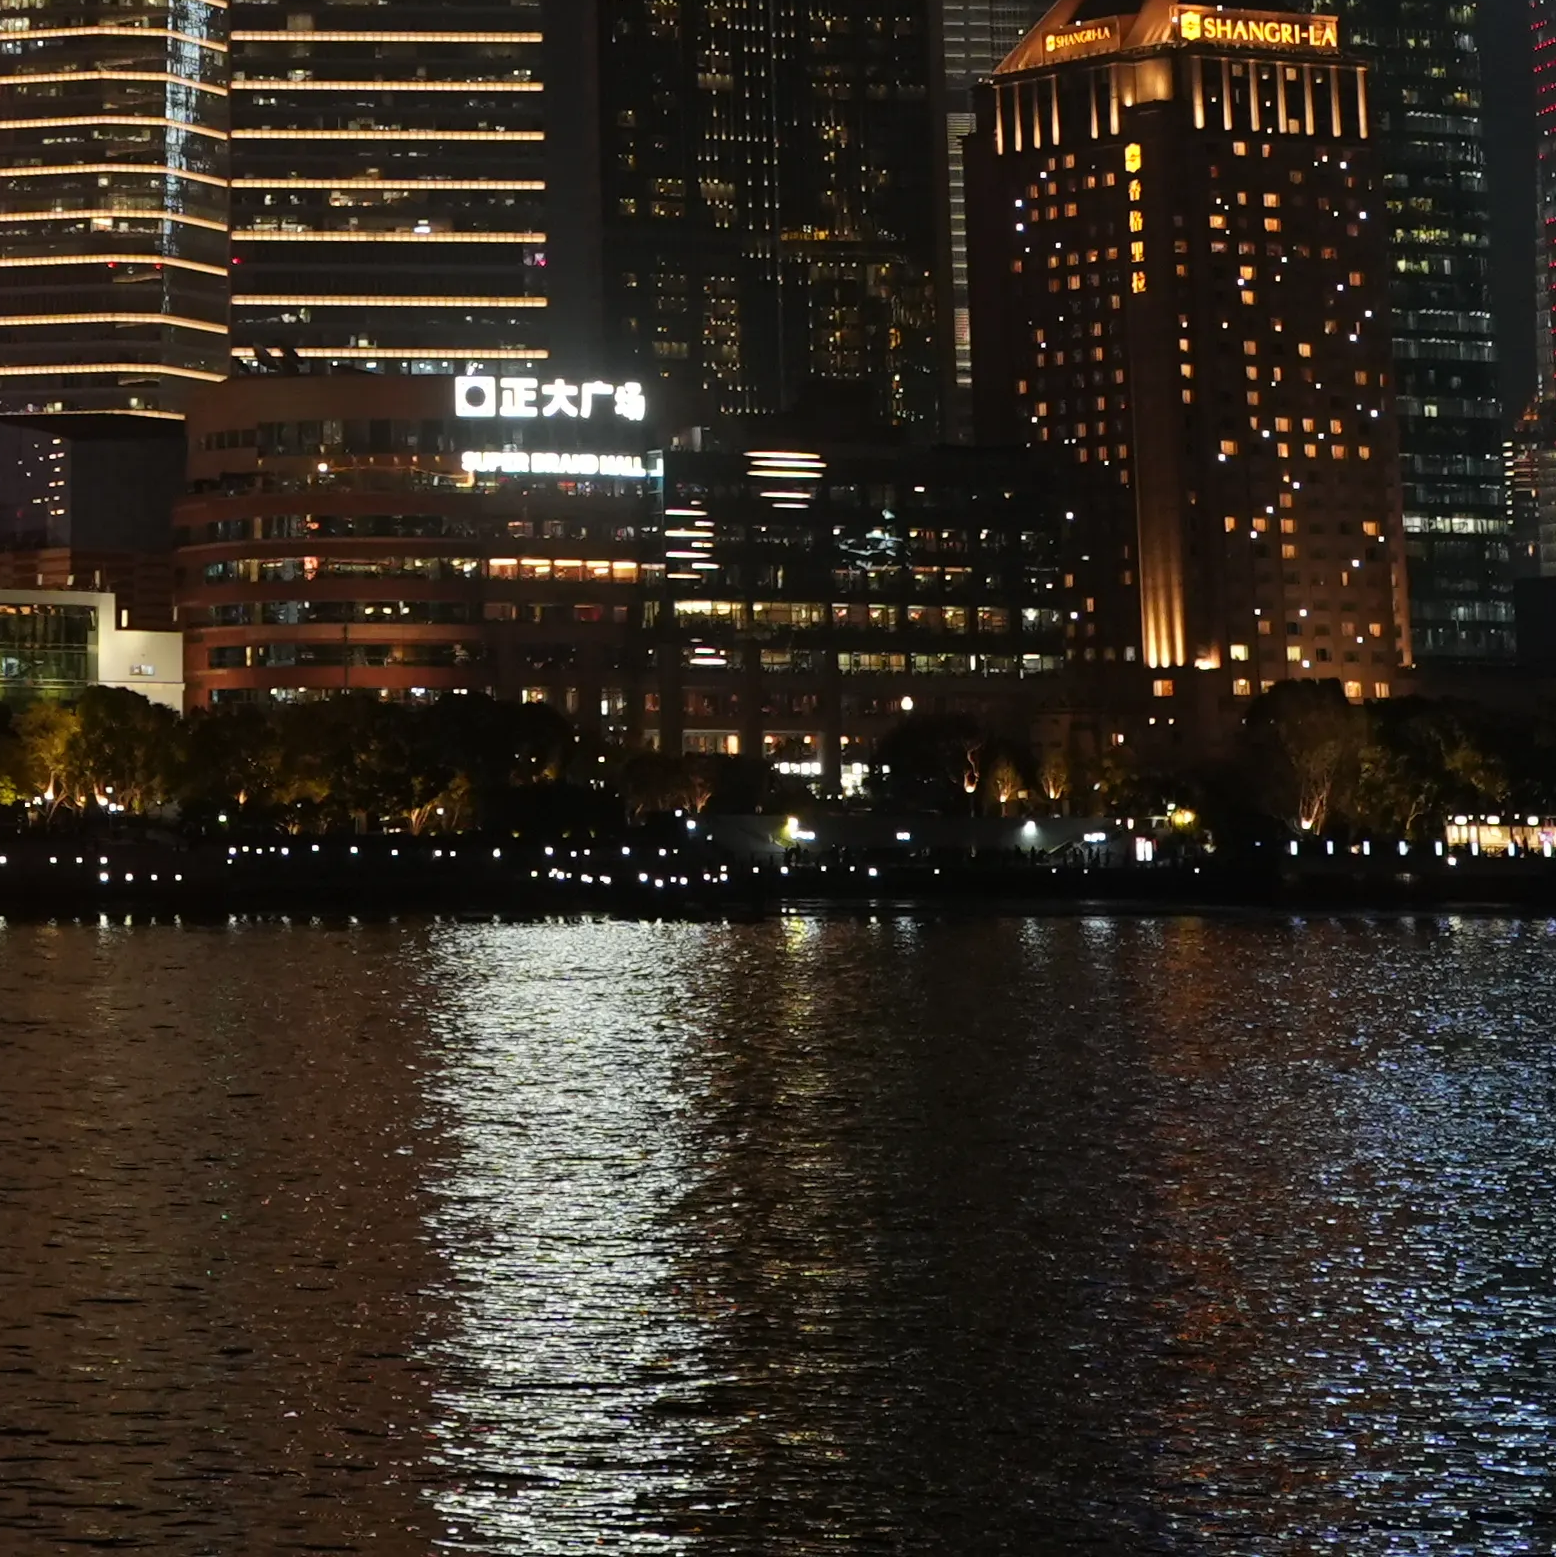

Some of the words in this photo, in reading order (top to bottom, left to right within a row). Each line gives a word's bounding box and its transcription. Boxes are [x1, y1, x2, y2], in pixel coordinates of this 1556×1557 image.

[1055, 26, 1111, 50] SHANGRI-LA
[1203, 16, 1338, 48] SHANGRI-LA
[1128, 179, 1147, 294] 香格里拉
[499, 377, 646, 422] 正大广场
[461, 451, 530, 473] SUPER
[530, 452, 599, 475] BRAND
[599, 455, 647, 478] MALL
